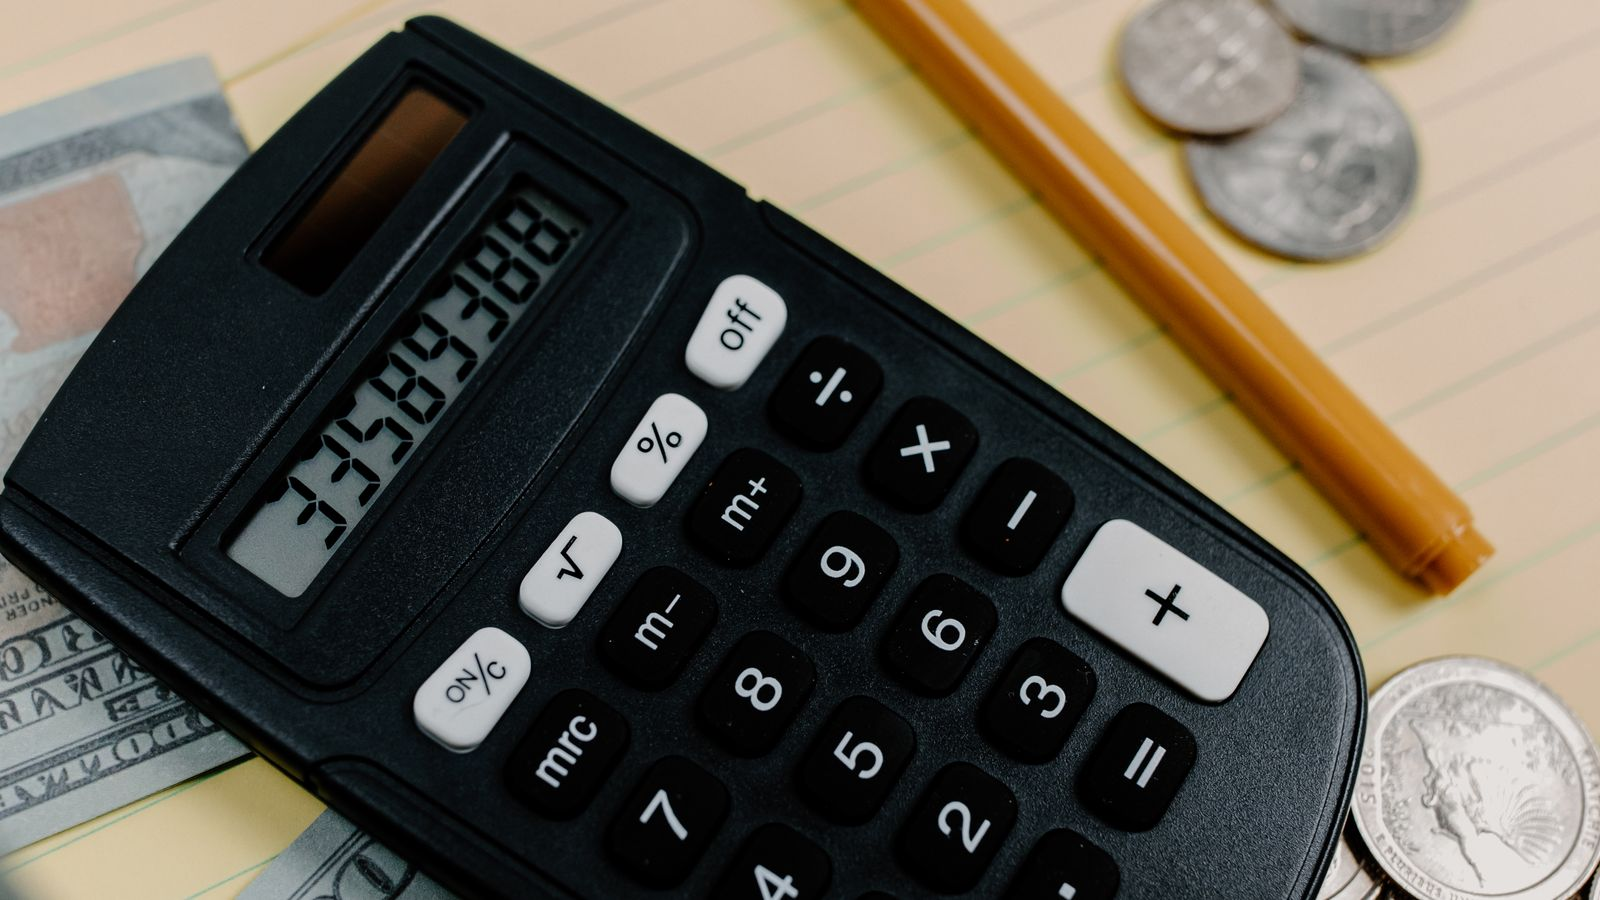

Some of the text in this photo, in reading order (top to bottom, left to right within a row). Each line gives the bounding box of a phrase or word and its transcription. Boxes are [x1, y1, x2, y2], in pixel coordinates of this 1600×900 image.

[720, 299, 760, 350] off
[821, 546, 865, 587] 9
[922, 610, 965, 651] 6
[445, 652, 507, 704] ON/C
[735, 668, 782, 711] 8
[1020, 676, 1066, 718] 3
[536, 716, 597, 787] mrc
[834, 732, 883, 778] 5
[640, 790, 687, 839] 7
[938, 802, 990, 852] 2
[755, 865, 798, 900] 4
